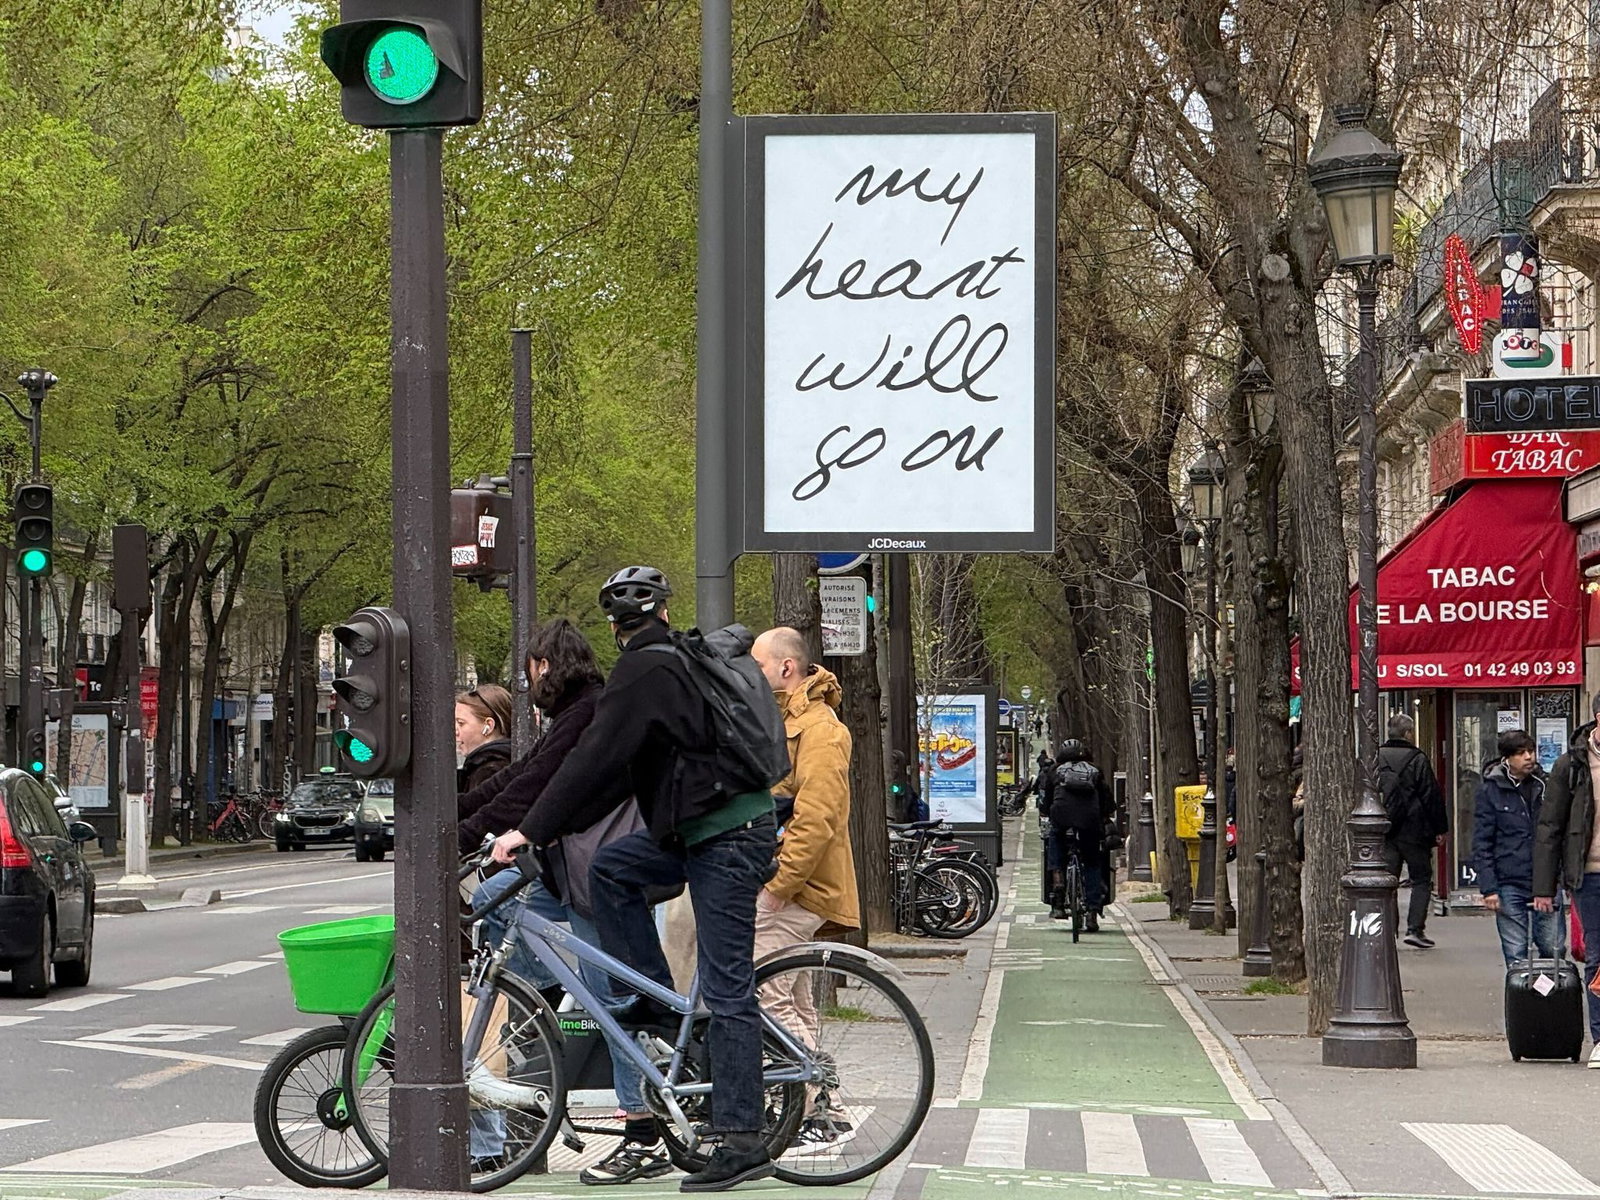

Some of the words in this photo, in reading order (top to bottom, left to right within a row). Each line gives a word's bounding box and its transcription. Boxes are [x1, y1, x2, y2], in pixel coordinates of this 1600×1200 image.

[835, 165, 983, 246] my
[776, 222, 1025, 300] heart
[796, 314, 1008, 401] will
[792, 425, 886, 500] go
[901, 425, 1003, 472] on
[1491, 448, 1584, 474] TABAC
[868, 538, 926, 549] JCDecaux
[1427, 565, 1516, 589] TABAC
[1356, 604, 1391, 625] E
[1399, 604, 1433, 624] LA
[1440, 599, 1549, 622] BOURSE
[1396, 663, 1449, 678] S/SOL
[1464, 663, 1482, 677] 01
[1487, 663, 1507, 677] 42
[1510, 662, 1530, 676] 49
[1533, 661, 1553, 675] 03
[1557, 661, 1576, 675] 93
[560, 1019, 601, 1030] imeBike
